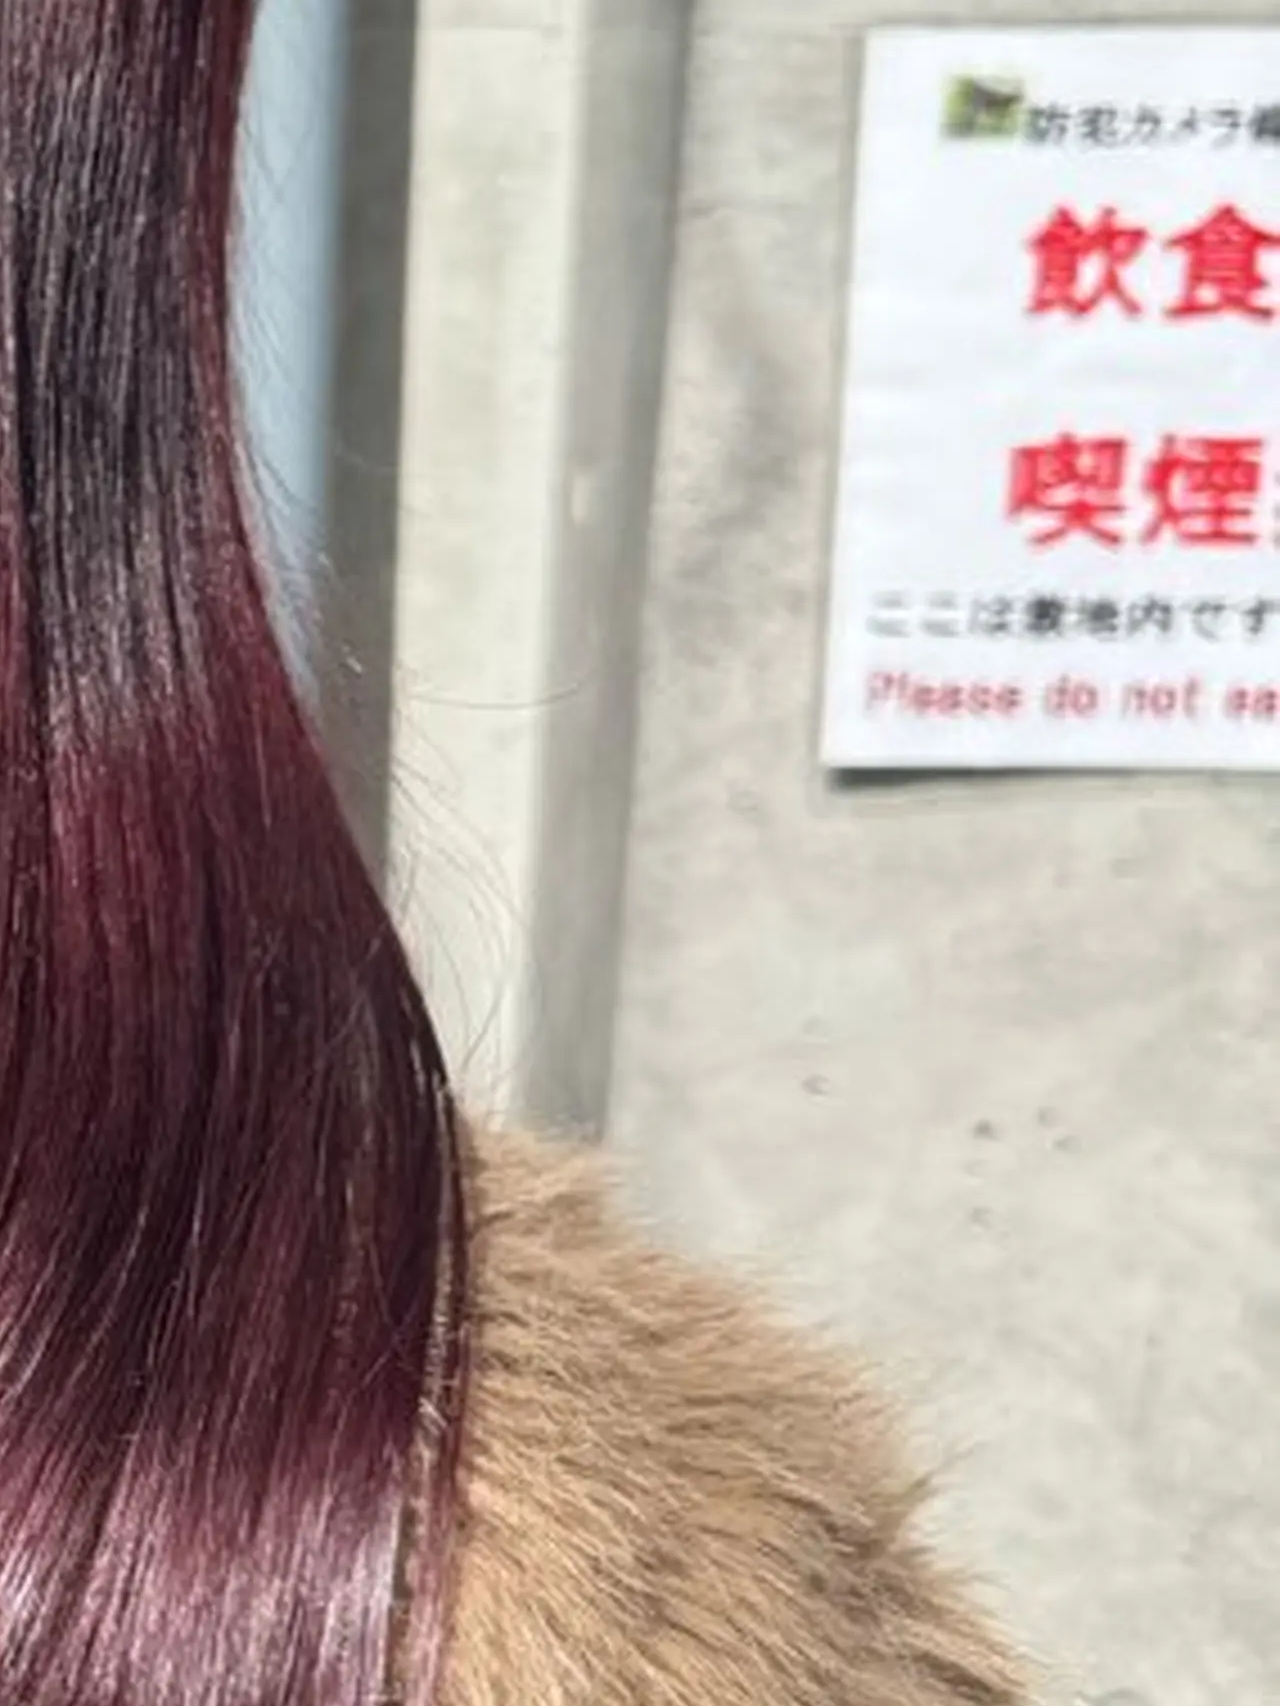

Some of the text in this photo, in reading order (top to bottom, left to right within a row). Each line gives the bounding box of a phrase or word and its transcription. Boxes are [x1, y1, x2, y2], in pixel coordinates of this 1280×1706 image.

[1026, 204, 1280, 322] 飲食
[1006, 431, 1280, 550] 喫煙
[864, 669, 1024, 717] Please
[1044, 671, 1099, 717] do
[1122, 675, 1203, 717] not
